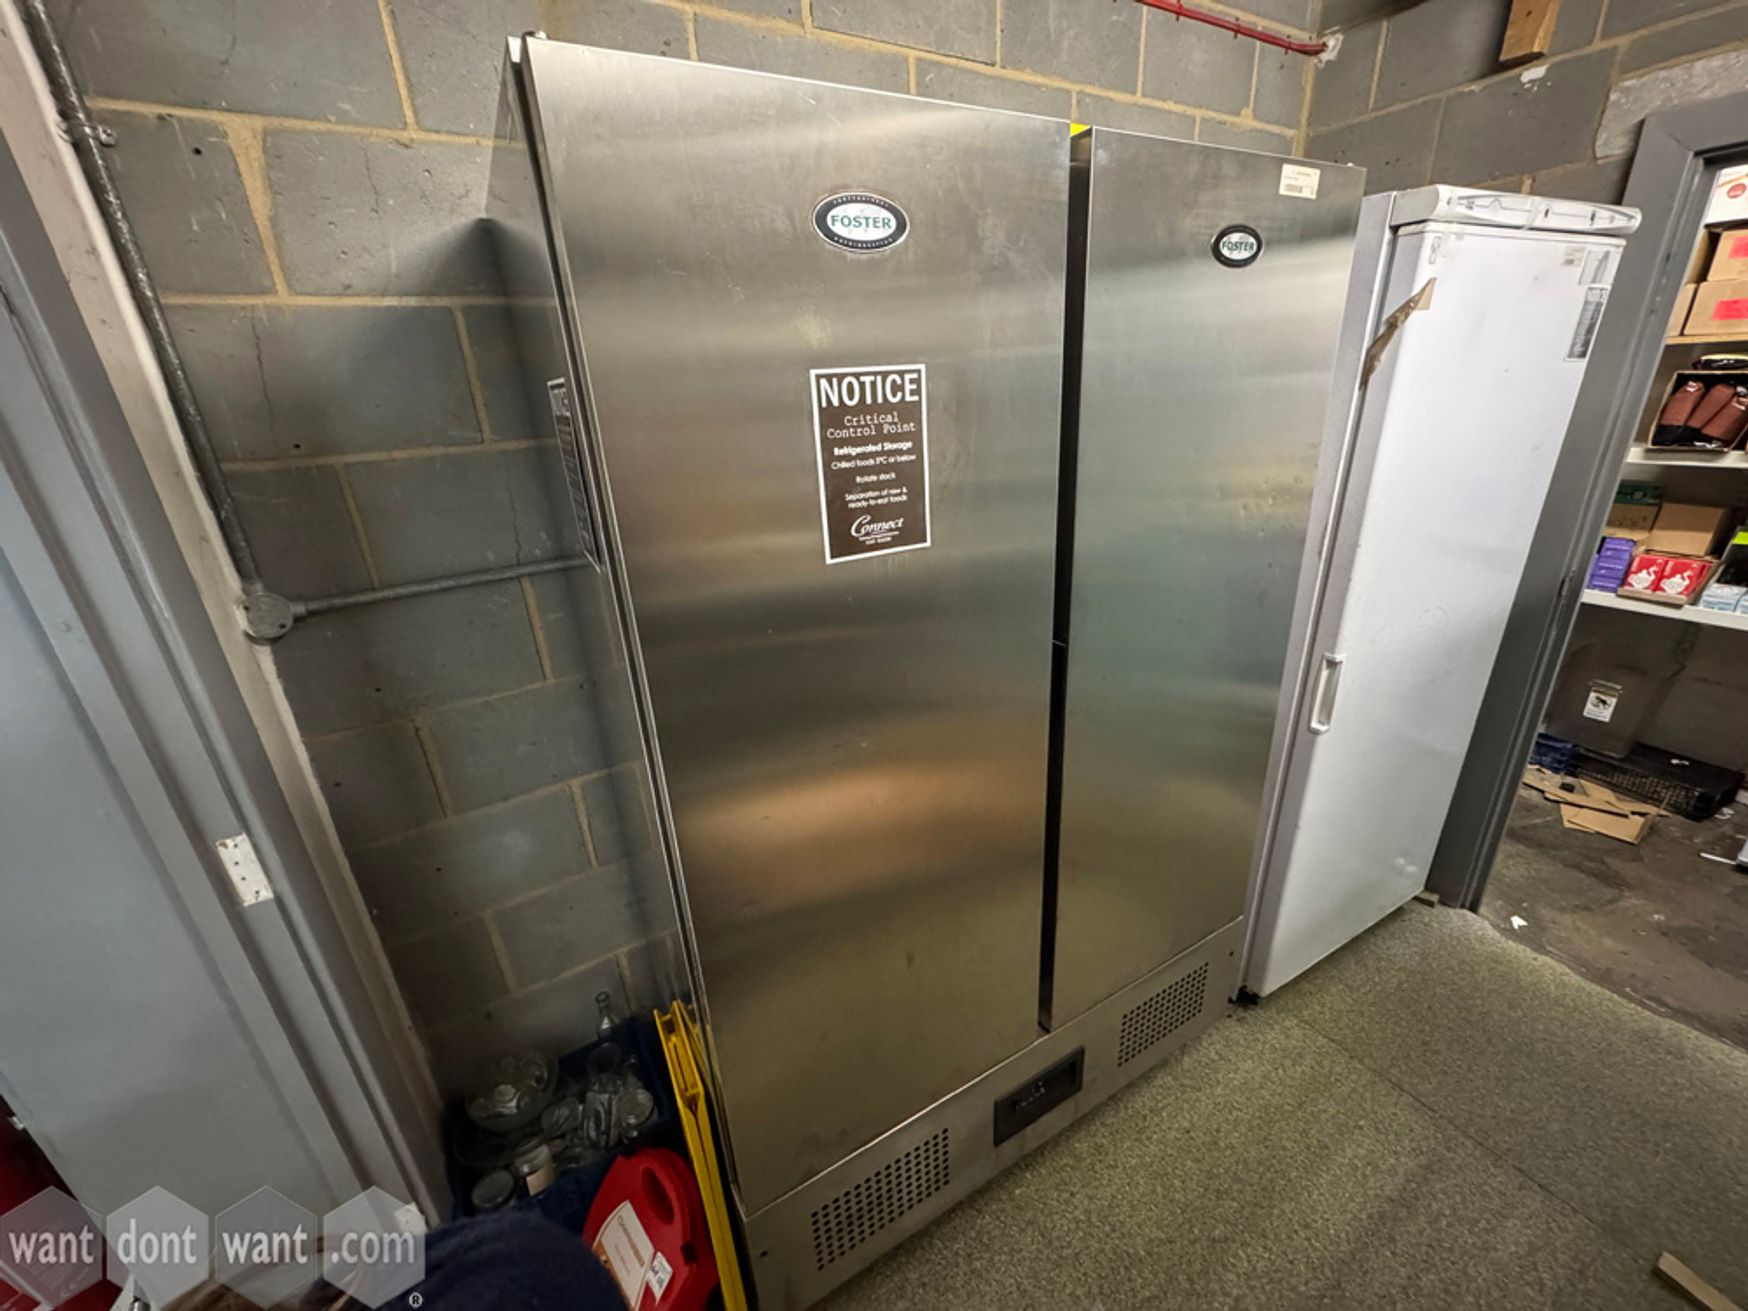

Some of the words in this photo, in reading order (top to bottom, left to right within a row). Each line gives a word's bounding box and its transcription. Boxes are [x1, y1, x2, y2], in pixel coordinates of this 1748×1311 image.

[831, 215, 892, 229] FOSTER
[1222, 240, 1254, 252] FOSTER
[819, 372, 920, 408] NOTICE
[843, 412, 899, 426] Critical
[826, 425, 876, 439] Control
[883, 422, 917, 435] Point
[833, 443, 882, 456] Refrigerated
[883, 440, 913, 451] Storage
[831, 459, 855, 470] Chilled
[856, 457, 875, 466] foods
[896, 454, 917, 462] below
[855, 475, 878, 483] Rotate
[879, 472, 896, 480] stock
[845, 490, 880, 501] Separation
[851, 514, 904, 538] Connect
